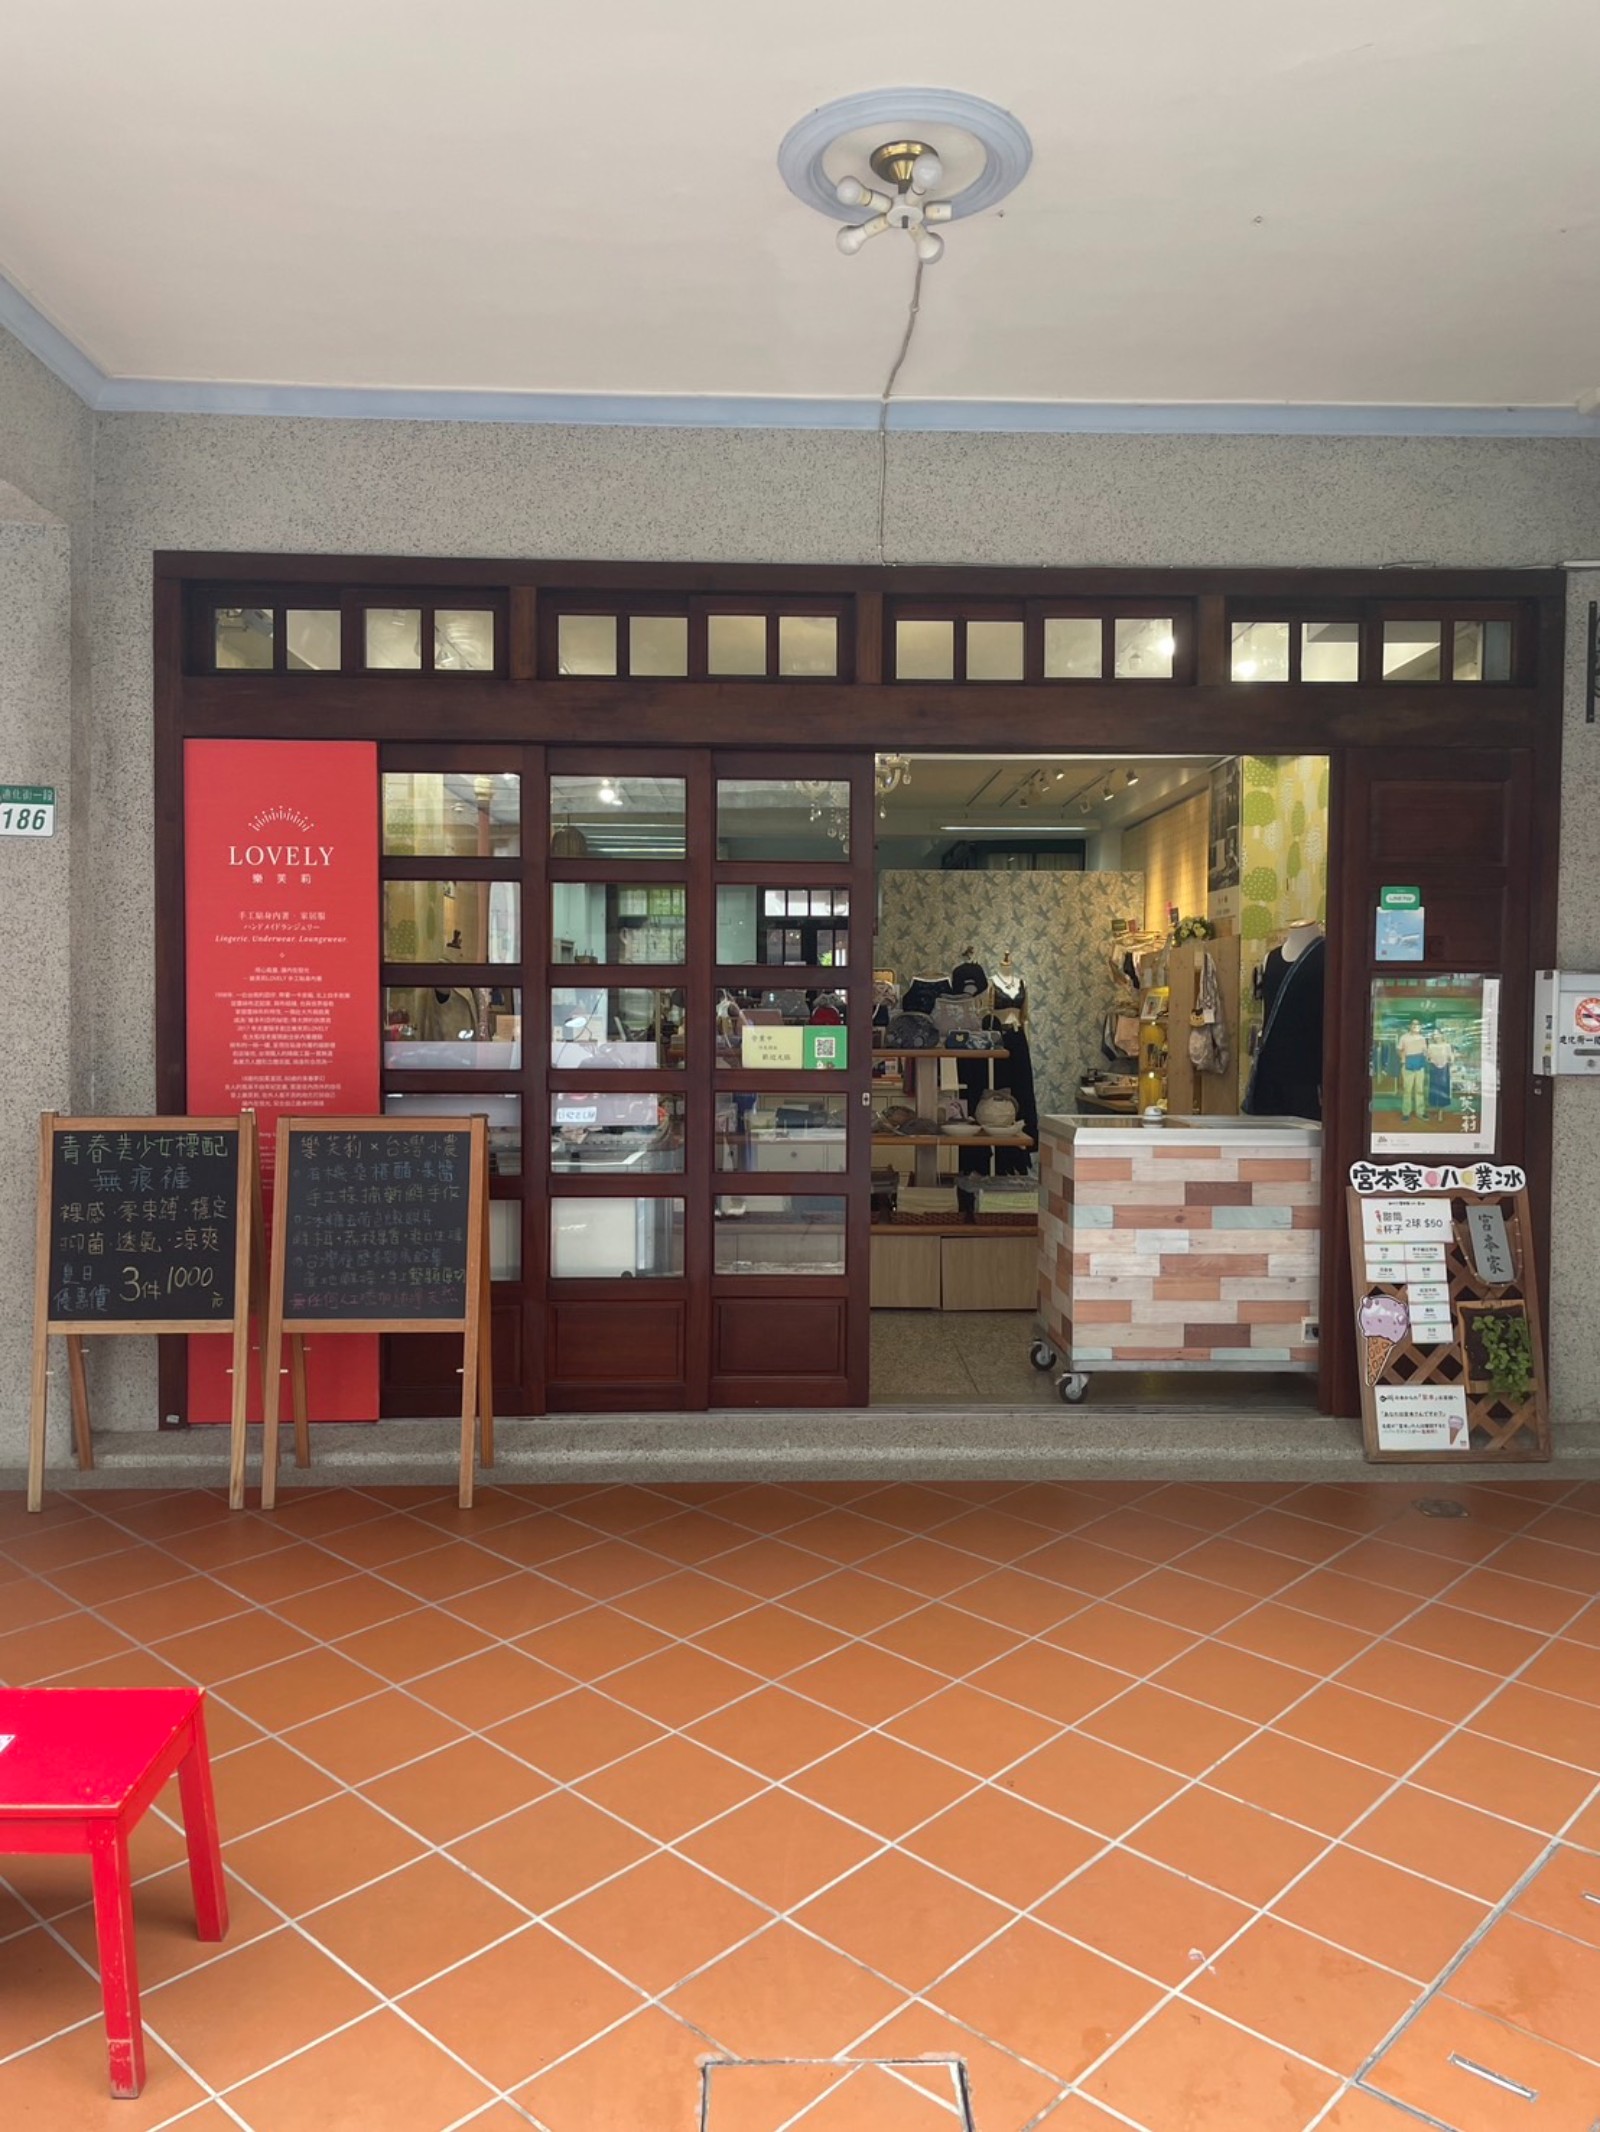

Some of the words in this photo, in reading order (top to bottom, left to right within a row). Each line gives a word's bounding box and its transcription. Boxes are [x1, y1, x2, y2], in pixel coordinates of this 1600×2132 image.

[3, 808, 46, 830] 186
[228, 845, 335, 866] LOVELY
[252, 873, 311, 884] 樂芙莉
[60, 1132, 229, 1165] 青春美少女標配
[89, 1162, 193, 1193] 無痕褲
[1353, 1163, 1422, 1190] 宮本家
[1384, 1225, 1403, 1235] 杯子
[1424, 1219, 1443, 1229] $50
[53, 1285, 111, 1312] 優惠價
[167, 1265, 214, 1294] 1000
[211, 1291, 224, 1310] 元
